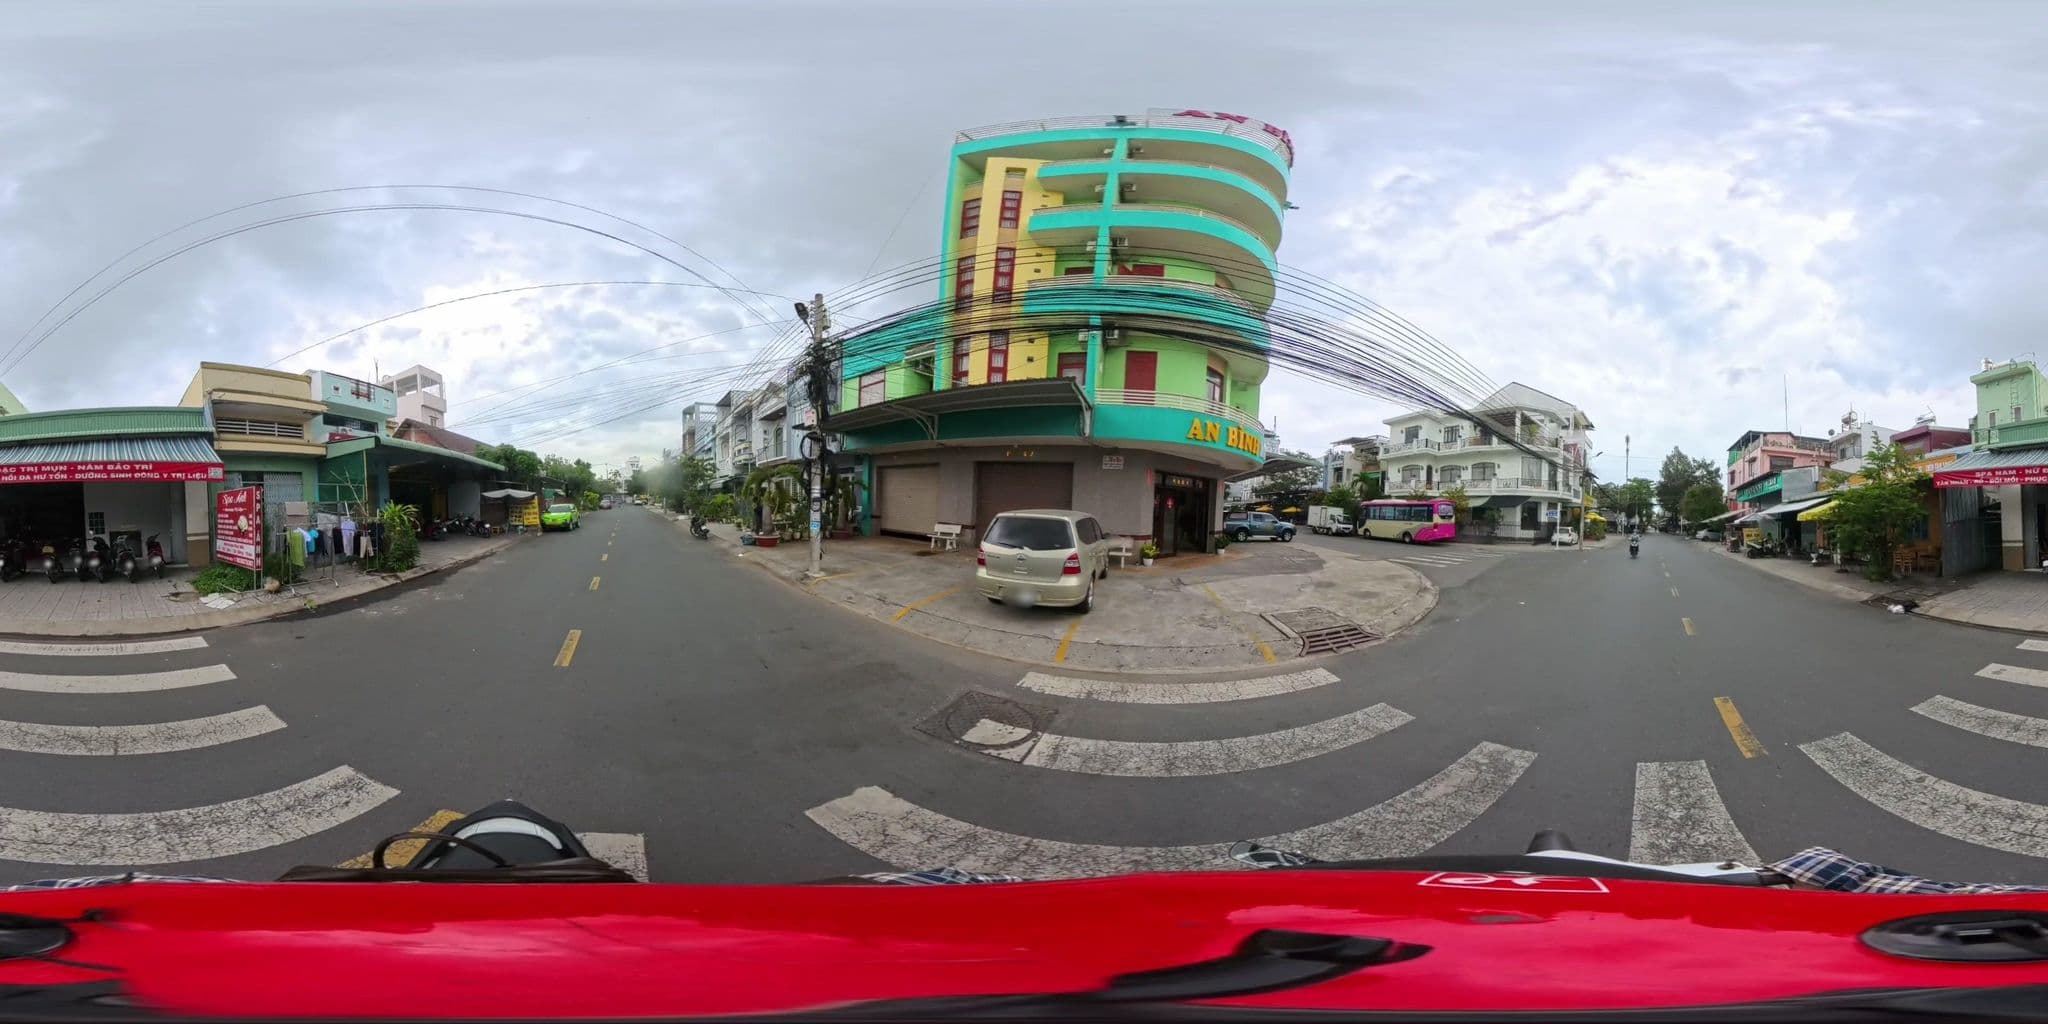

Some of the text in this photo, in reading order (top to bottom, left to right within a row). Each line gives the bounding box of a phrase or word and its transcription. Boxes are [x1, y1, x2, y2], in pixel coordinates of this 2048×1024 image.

[1187, 418, 1260, 456] AN BÌNH
[0, 466, 16, 474] ẶC
[41, 465, 67, 473] MỤN
[1975, 470, 1993, 478] SPA
